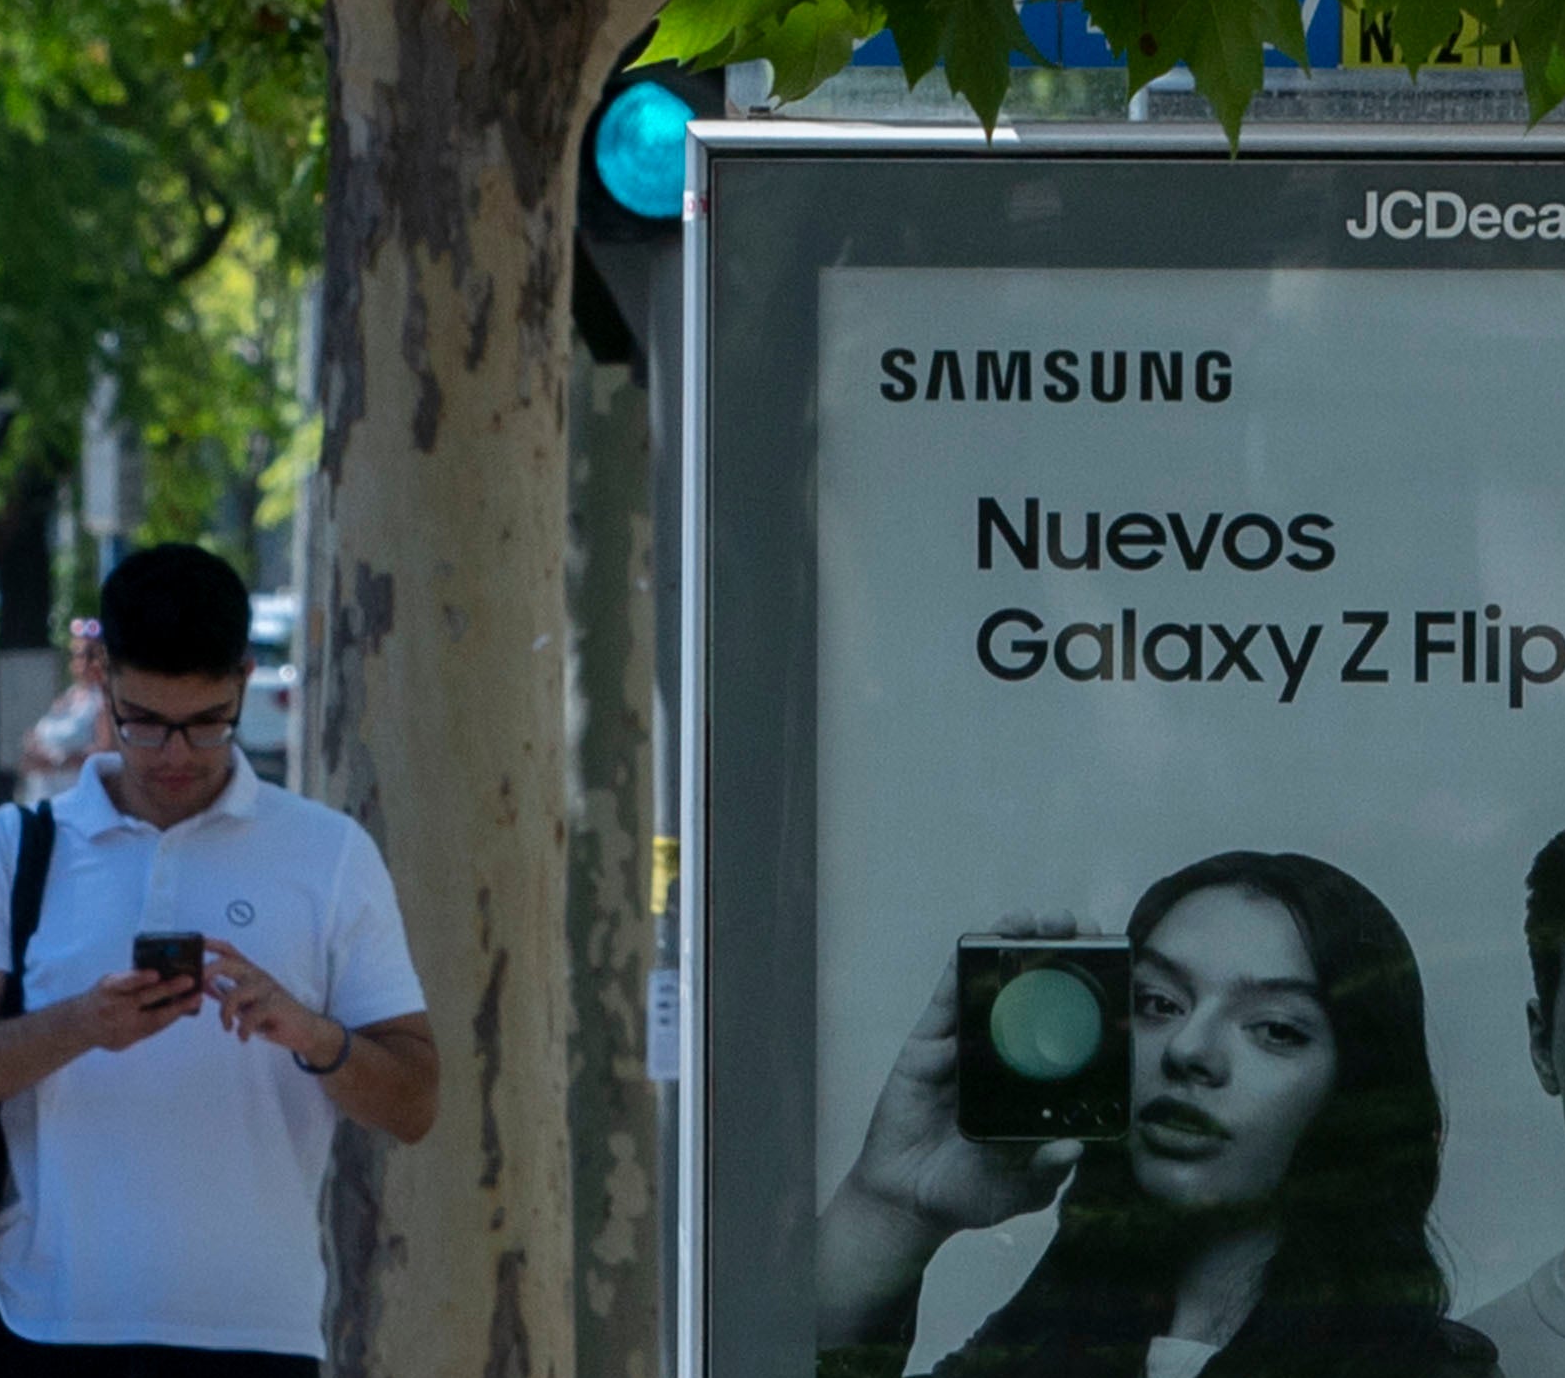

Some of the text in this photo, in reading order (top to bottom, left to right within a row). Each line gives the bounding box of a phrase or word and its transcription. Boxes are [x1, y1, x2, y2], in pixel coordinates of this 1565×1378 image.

[879, 347, 1233, 405] SAMSUNG
[977, 496, 1337, 572] Nuevos
[977, 607, 1324, 704] Galaxy
[1340, 610, 1390, 684] Z
